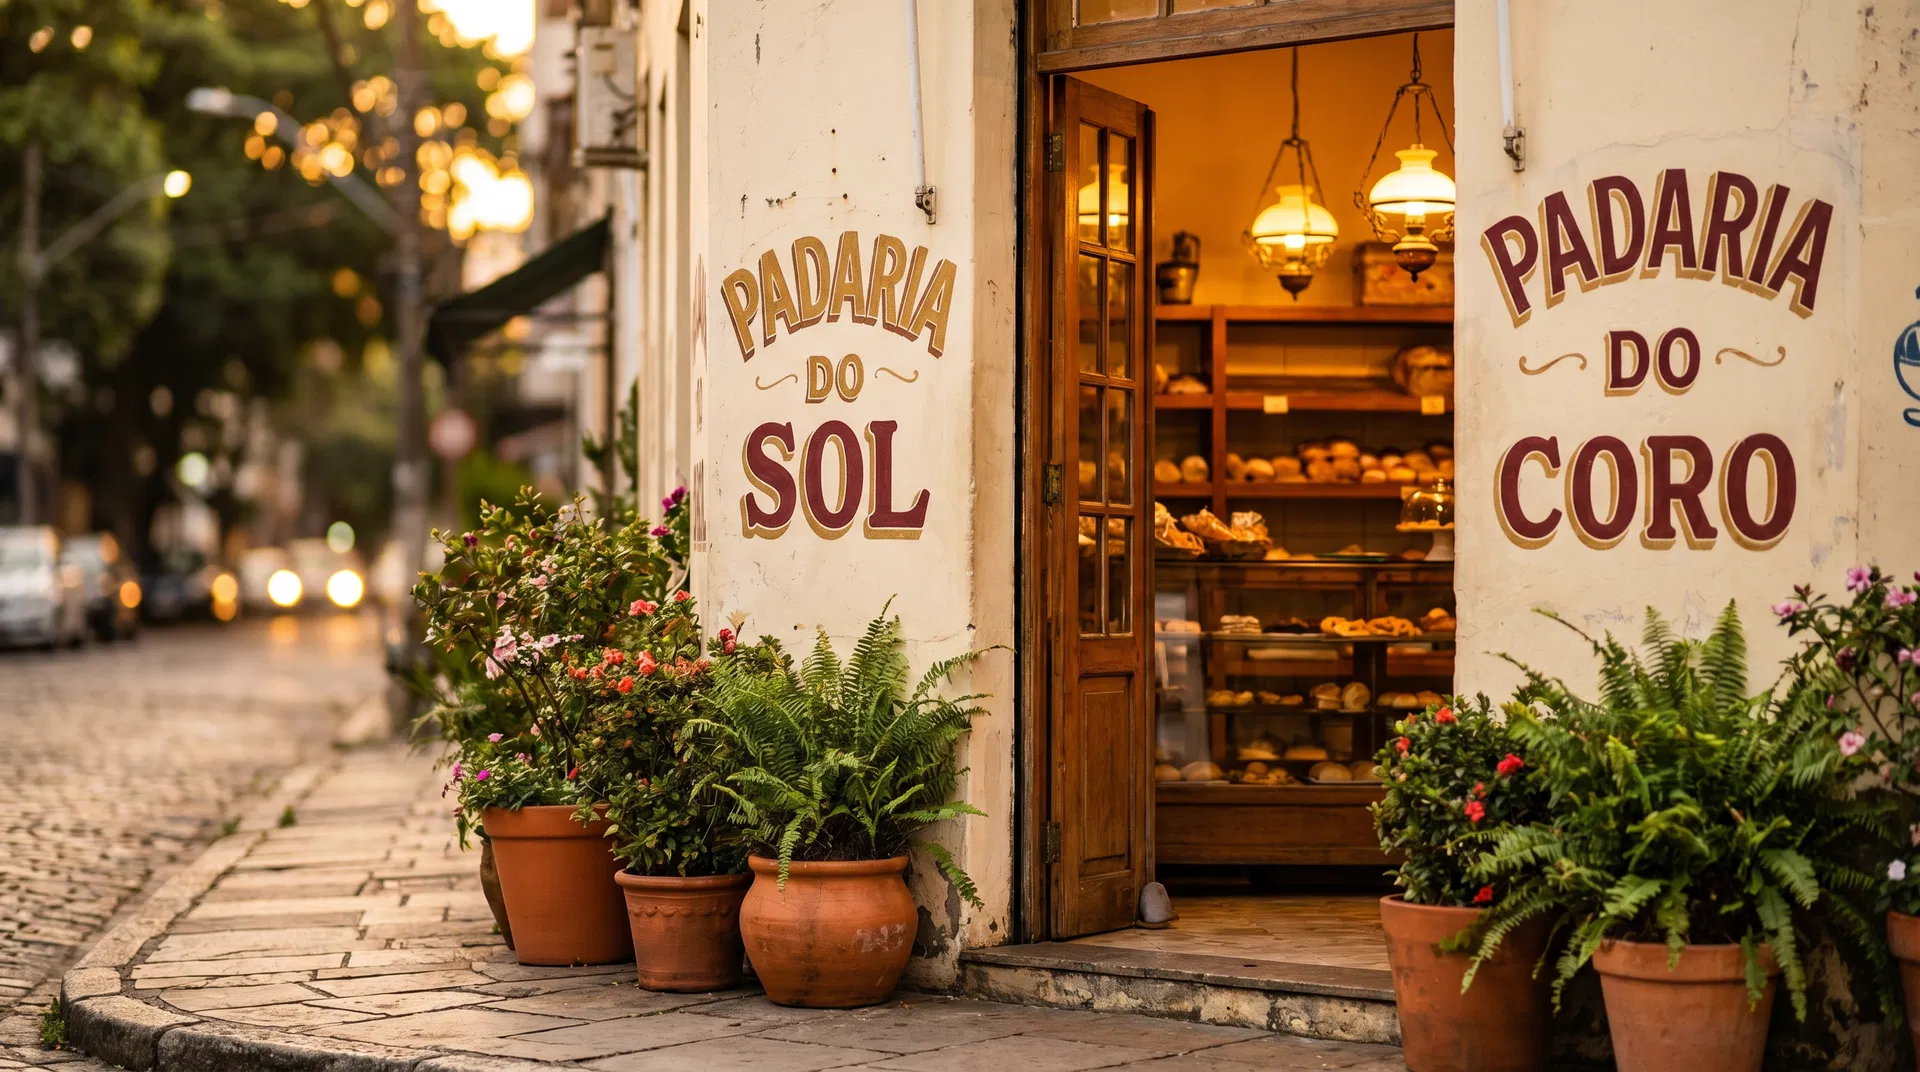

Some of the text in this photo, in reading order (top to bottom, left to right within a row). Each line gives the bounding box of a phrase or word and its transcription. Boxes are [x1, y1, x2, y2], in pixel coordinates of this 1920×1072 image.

[720, 230, 958, 363] PADARIA
[1480, 168, 1834, 329] PADARIA
[805, 353, 864, 403] DO
[1604, 327, 1701, 397] DO
[740, 419, 931, 541] SOL
[1493, 432, 1797, 552] CORO
